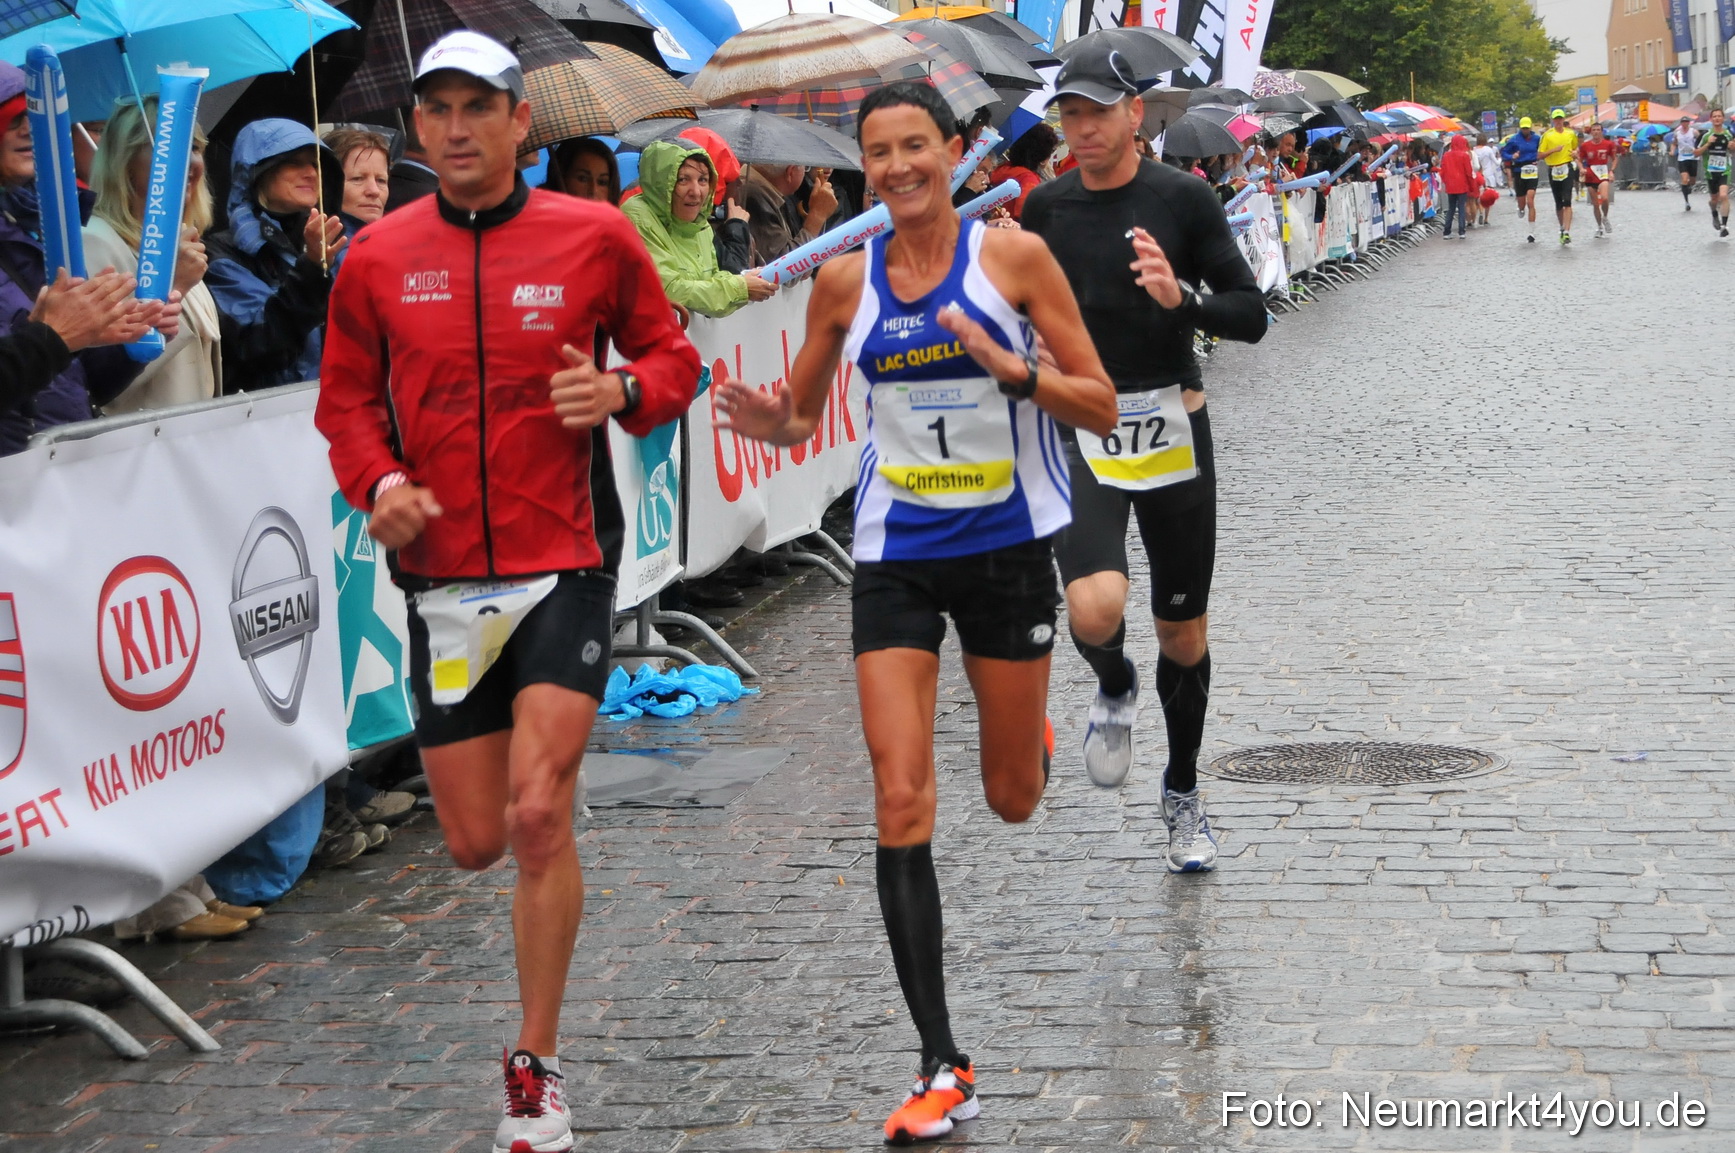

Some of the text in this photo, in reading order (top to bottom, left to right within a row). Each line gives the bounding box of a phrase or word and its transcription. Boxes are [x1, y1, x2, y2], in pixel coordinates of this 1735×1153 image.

[1239, 0, 1261, 51] Au
[139, 100, 177, 289] www.maxi-dsl.de
[965, 193, 1014, 221] iseCenter
[785, 221, 886, 276] TUI ReiseCenter
[403, 270, 448, 293] HDI
[883, 313, 925, 333] HEITEC
[876, 340, 967, 373] LAC QUELL
[1116, 398, 1149, 411] OCK
[927, 415, 950, 459] 1
[1101, 415, 1170, 456] 672
[905, 471, 985, 490] Christine
[110, 587, 189, 681] KIA
[236, 591, 311, 646] NISSAN
[83, 708, 226, 811] KIA MOTORS
